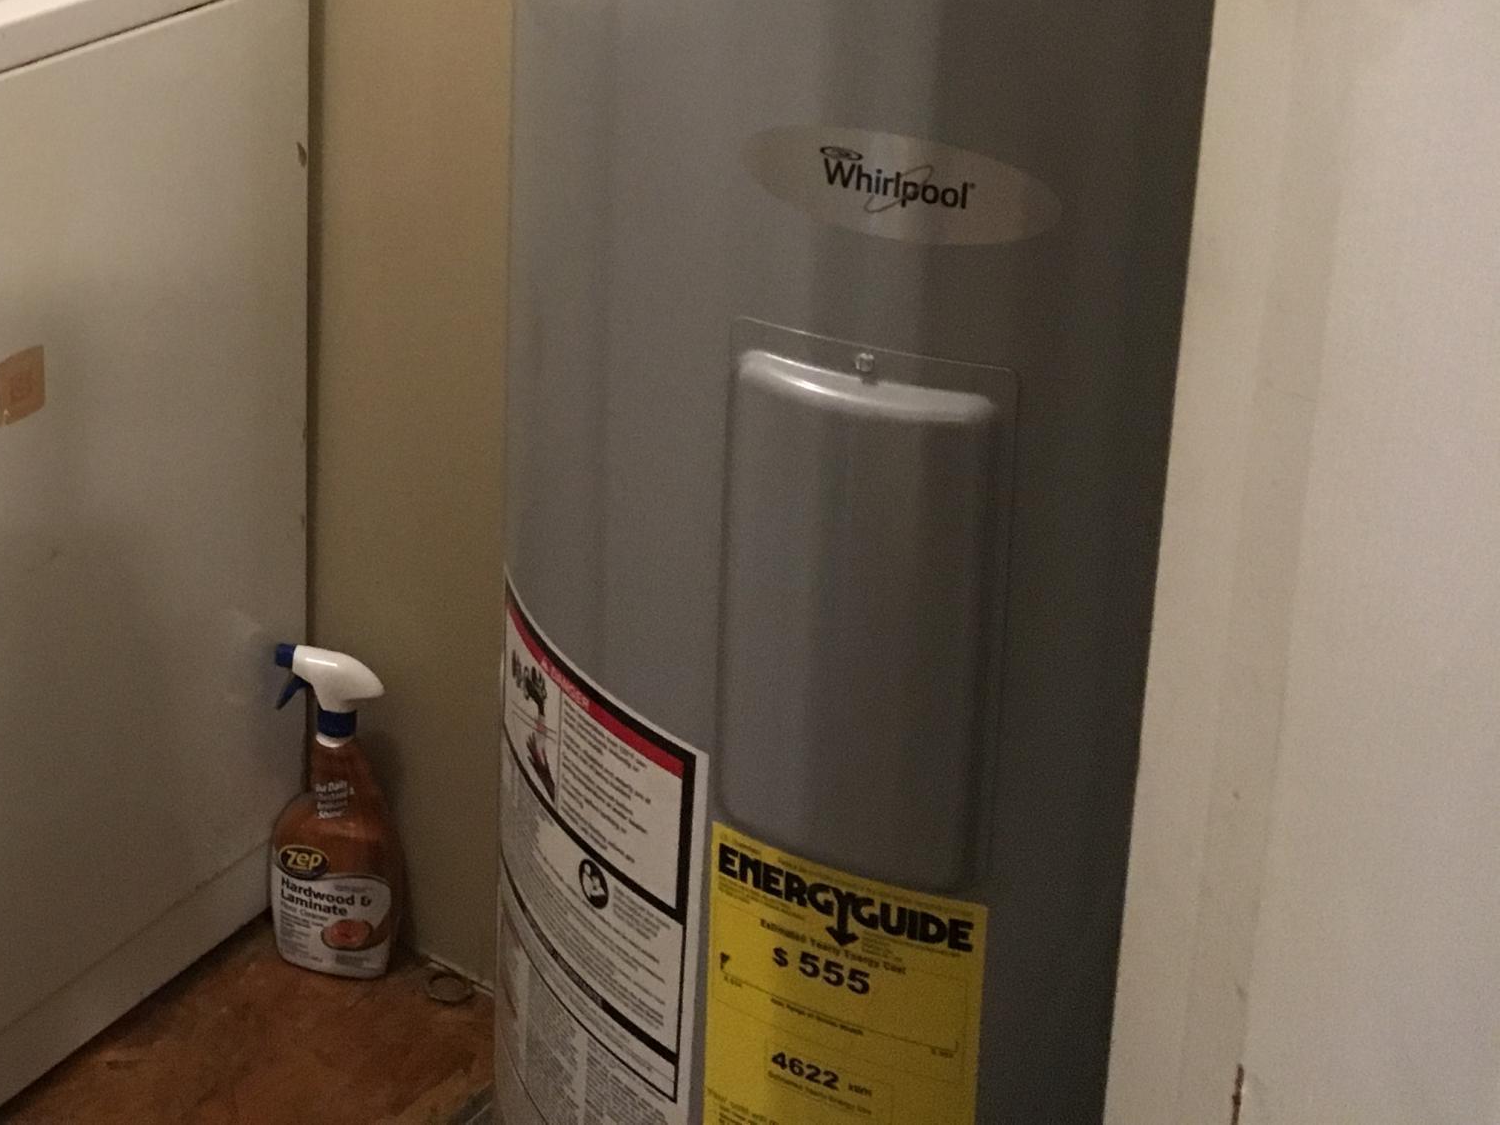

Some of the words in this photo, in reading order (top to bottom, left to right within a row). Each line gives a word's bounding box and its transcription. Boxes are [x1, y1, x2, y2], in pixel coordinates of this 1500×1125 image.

[823, 157, 969, 210] Whirlpool
[280, 876, 356, 906] Hardwood
[360, 895, 373, 907] &
[280, 888, 349, 917] Laminate
[717, 842, 975, 953] ENERGYGUIDE
[772, 946, 789, 968] $
[798, 951, 871, 995] 555
[771, 1051, 840, 1092] 4622
